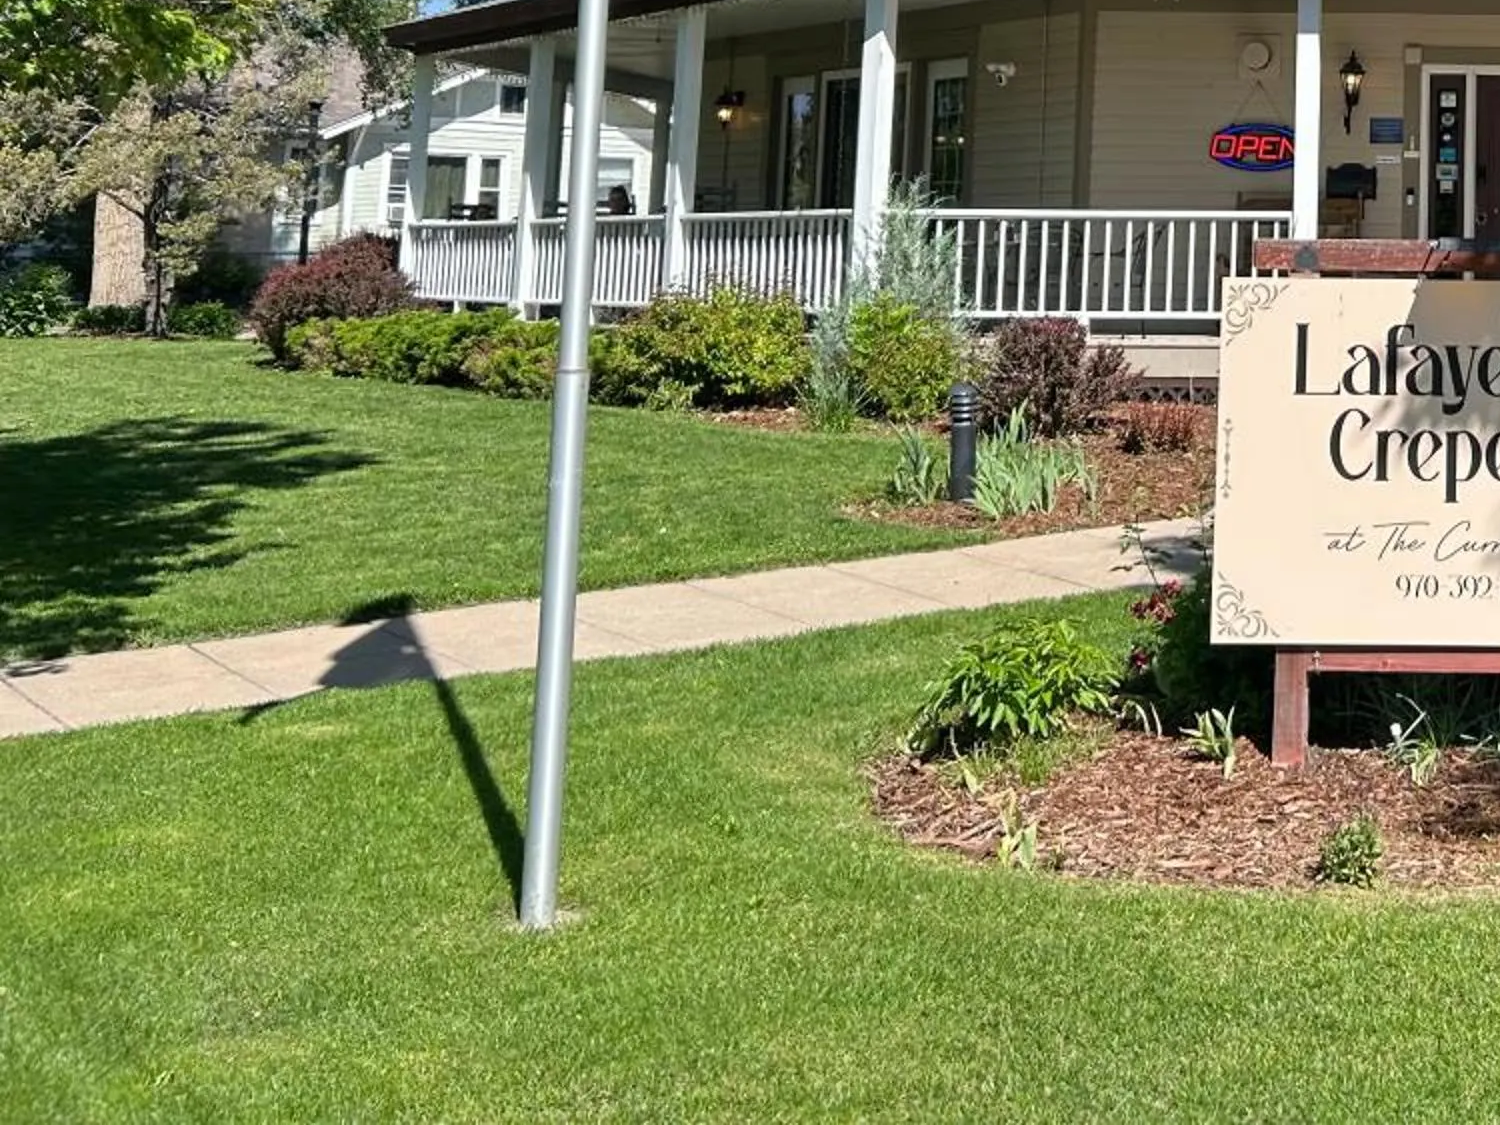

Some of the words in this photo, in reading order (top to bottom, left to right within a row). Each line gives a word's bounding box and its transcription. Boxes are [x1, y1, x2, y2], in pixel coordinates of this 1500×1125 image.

[1210, 134, 1295, 160] OPEN
[1322, 526, 1368, 552] at
[1372, 521, 1430, 562] The
